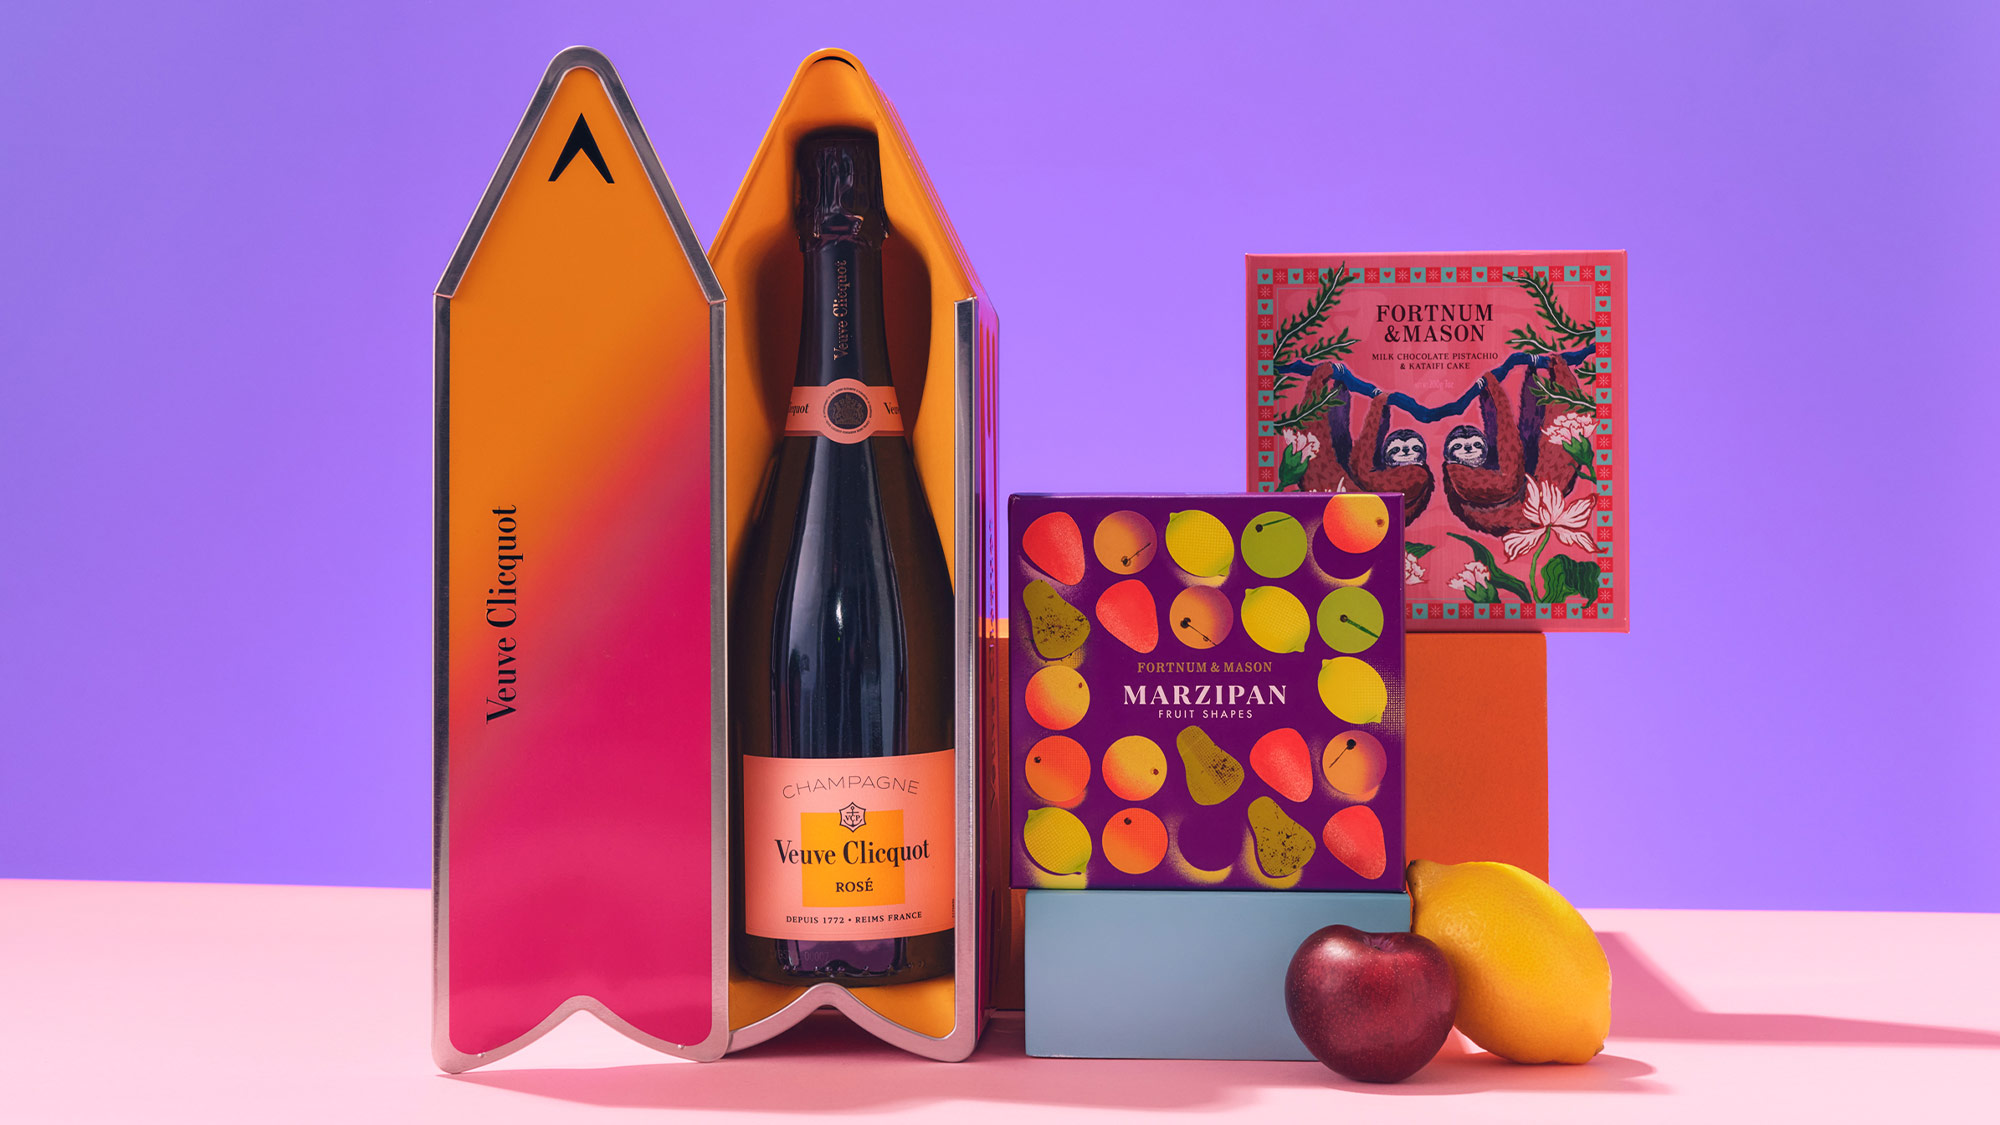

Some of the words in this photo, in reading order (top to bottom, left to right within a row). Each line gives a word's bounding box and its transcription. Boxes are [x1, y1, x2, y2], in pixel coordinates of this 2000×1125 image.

[832, 260, 851, 317] Clicquot
[1376, 303, 1494, 322] FORTNUM
[833, 320, 849, 361] Veuve
[1384, 324, 1486, 343] &MASON
[1372, 353, 1394, 361] MILK
[1397, 352, 1449, 360] CHOCOLATE
[1452, 352, 1499, 360] PISTACHIO
[1409, 362, 1444, 370] KATAIFI
[1447, 362, 1471, 370] CAKE
[486, 504, 524, 628] Clicquot
[1137, 662, 1207, 673] FORTNUM
[1210, 662, 1220, 673] &
[1223, 661, 1272, 673] MASON
[486, 636, 517, 725] Veuve
[1123, 685, 1287, 705] MARZIPAN
[1158, 709, 1195, 719] FRUIT
[1202, 709, 1253, 719] SHAPES
[782, 775, 920, 799] CHAMPAGNE
[774, 839, 836, 865] Veuve
[843, 839, 931, 868] Clicquot
[835, 877, 874, 893] ROSÉ
[786, 915, 819, 924] DEPUIS
[822, 916, 845, 924] 1772
[855, 914, 885, 924] REIMS
[888, 911, 922, 921] FRANCE
